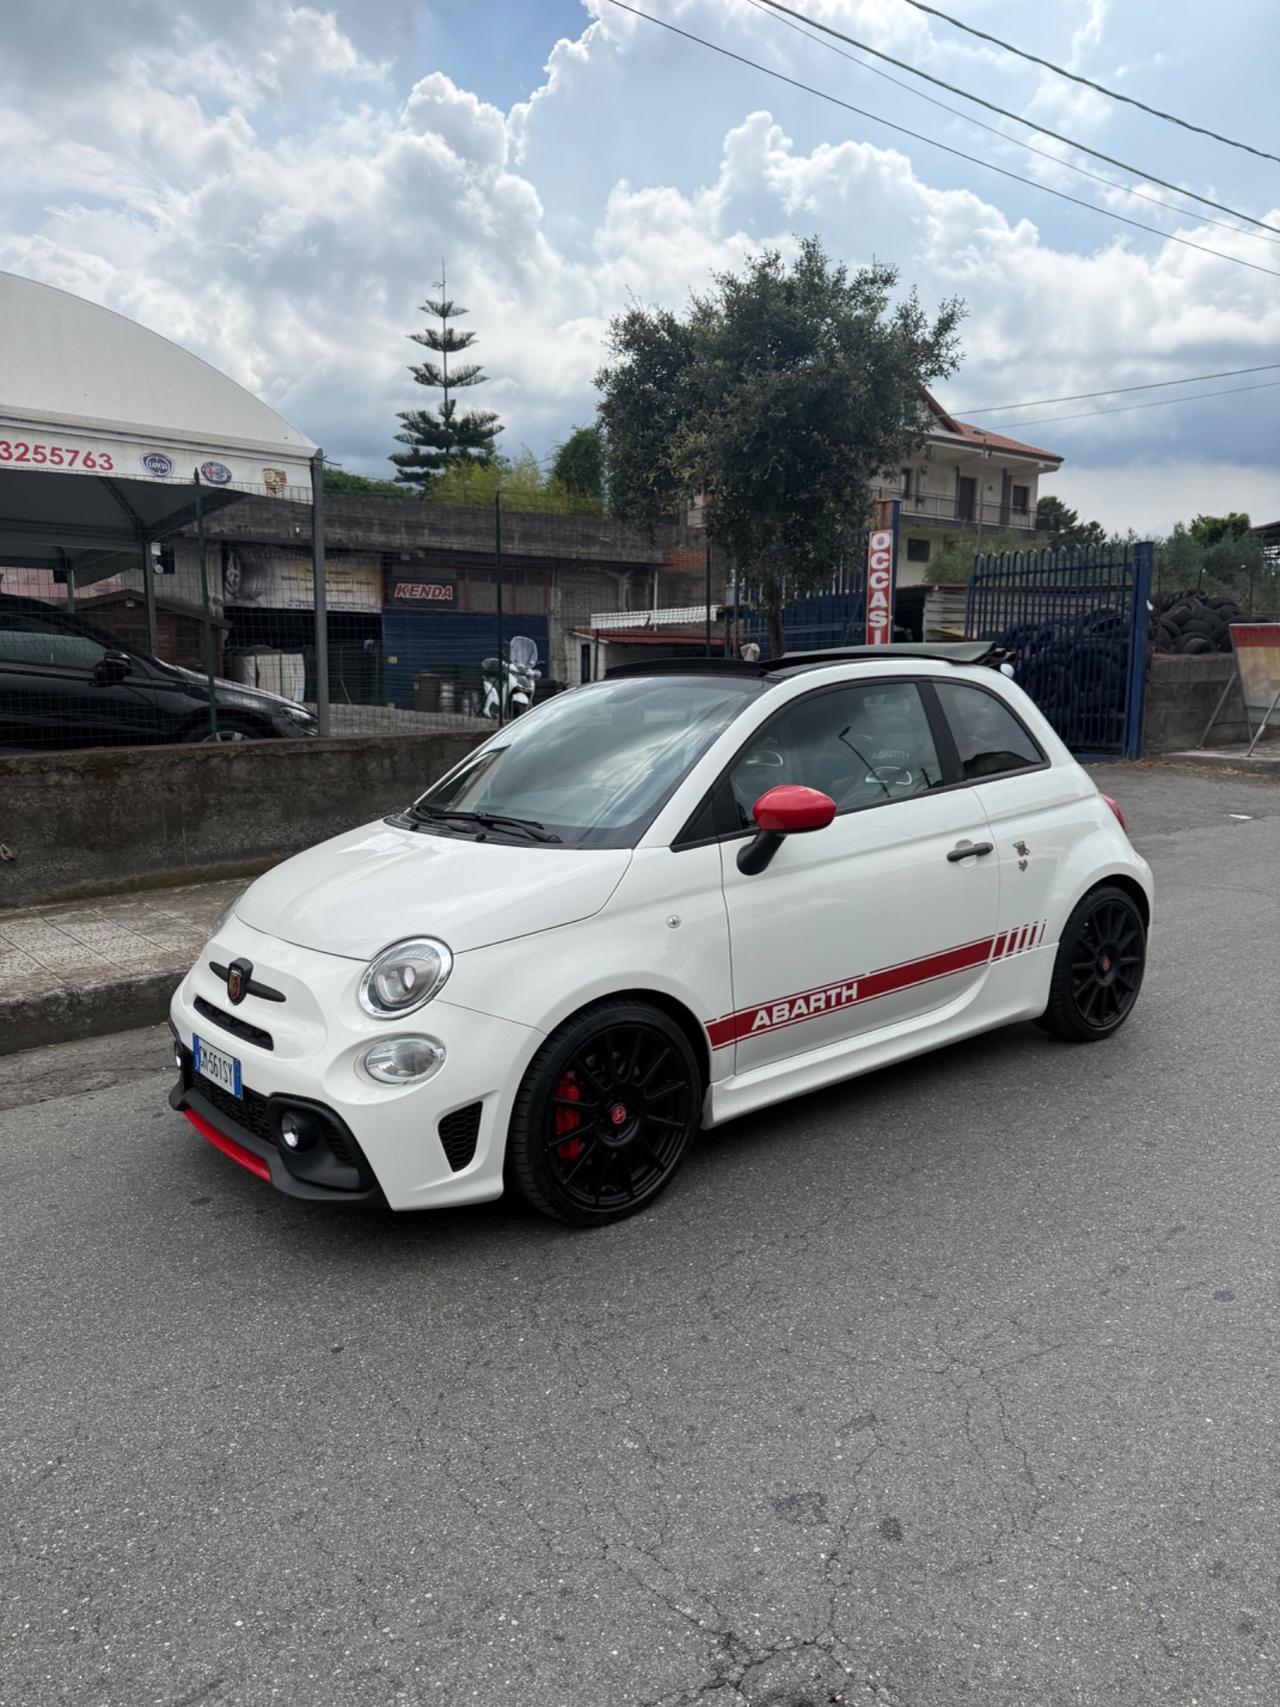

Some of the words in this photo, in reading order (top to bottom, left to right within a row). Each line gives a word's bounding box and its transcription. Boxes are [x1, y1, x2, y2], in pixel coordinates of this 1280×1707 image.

[0, 440, 114, 471] 3255763
[394, 583, 453, 600] KENDA
[869, 533, 890, 645] OCCASI
[751, 982, 858, 1031] ABARTH
